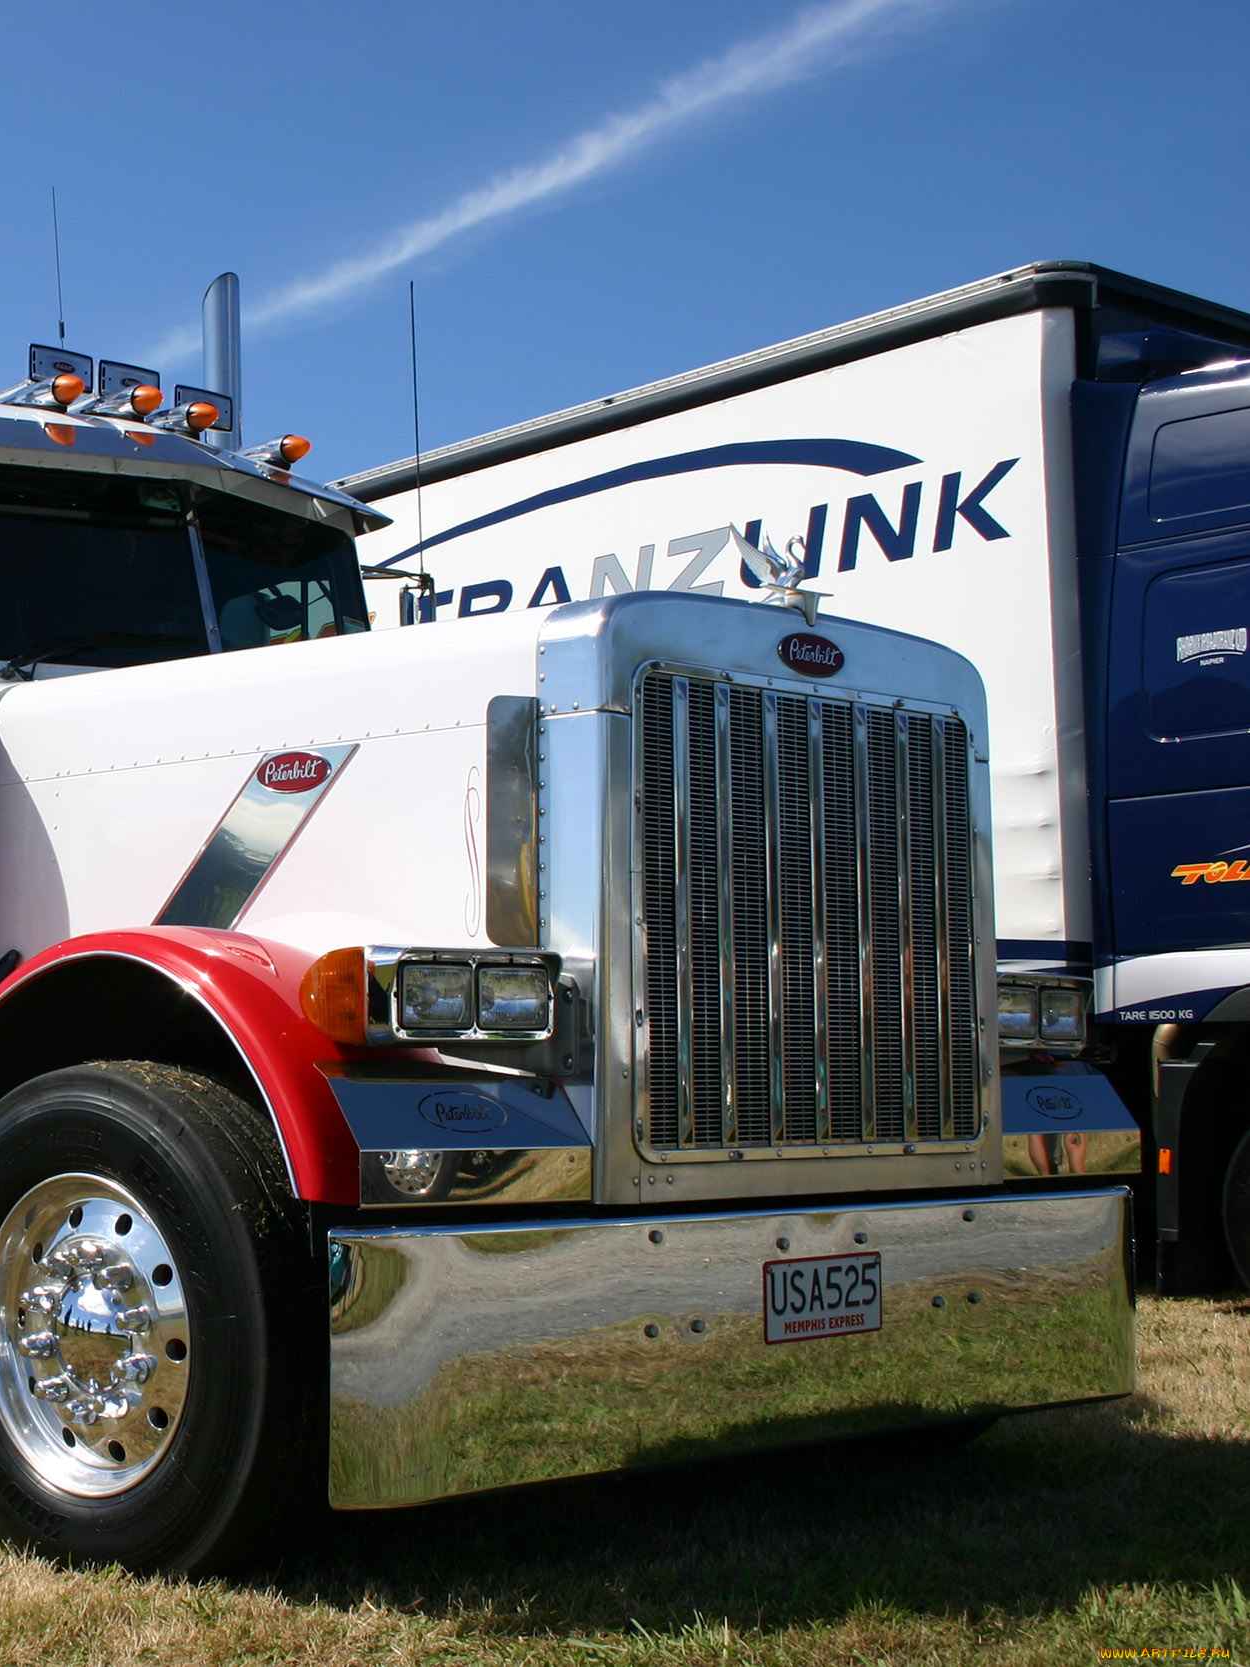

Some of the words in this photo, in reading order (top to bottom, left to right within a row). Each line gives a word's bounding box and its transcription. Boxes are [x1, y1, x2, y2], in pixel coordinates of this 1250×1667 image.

[789, 638, 840, 666] Peterbilt
[265, 760, 323, 784] Peterbilt
[1171, 860, 1250, 885] TOL
[1119, 1011, 1146, 1020] TARE
[1178, 1009, 1193, 1019] KG
[768, 1262, 877, 1315] USA525
[784, 1318, 826, 1334] MEMPHIS
[828, 1313, 865, 1329] EXPRESS
